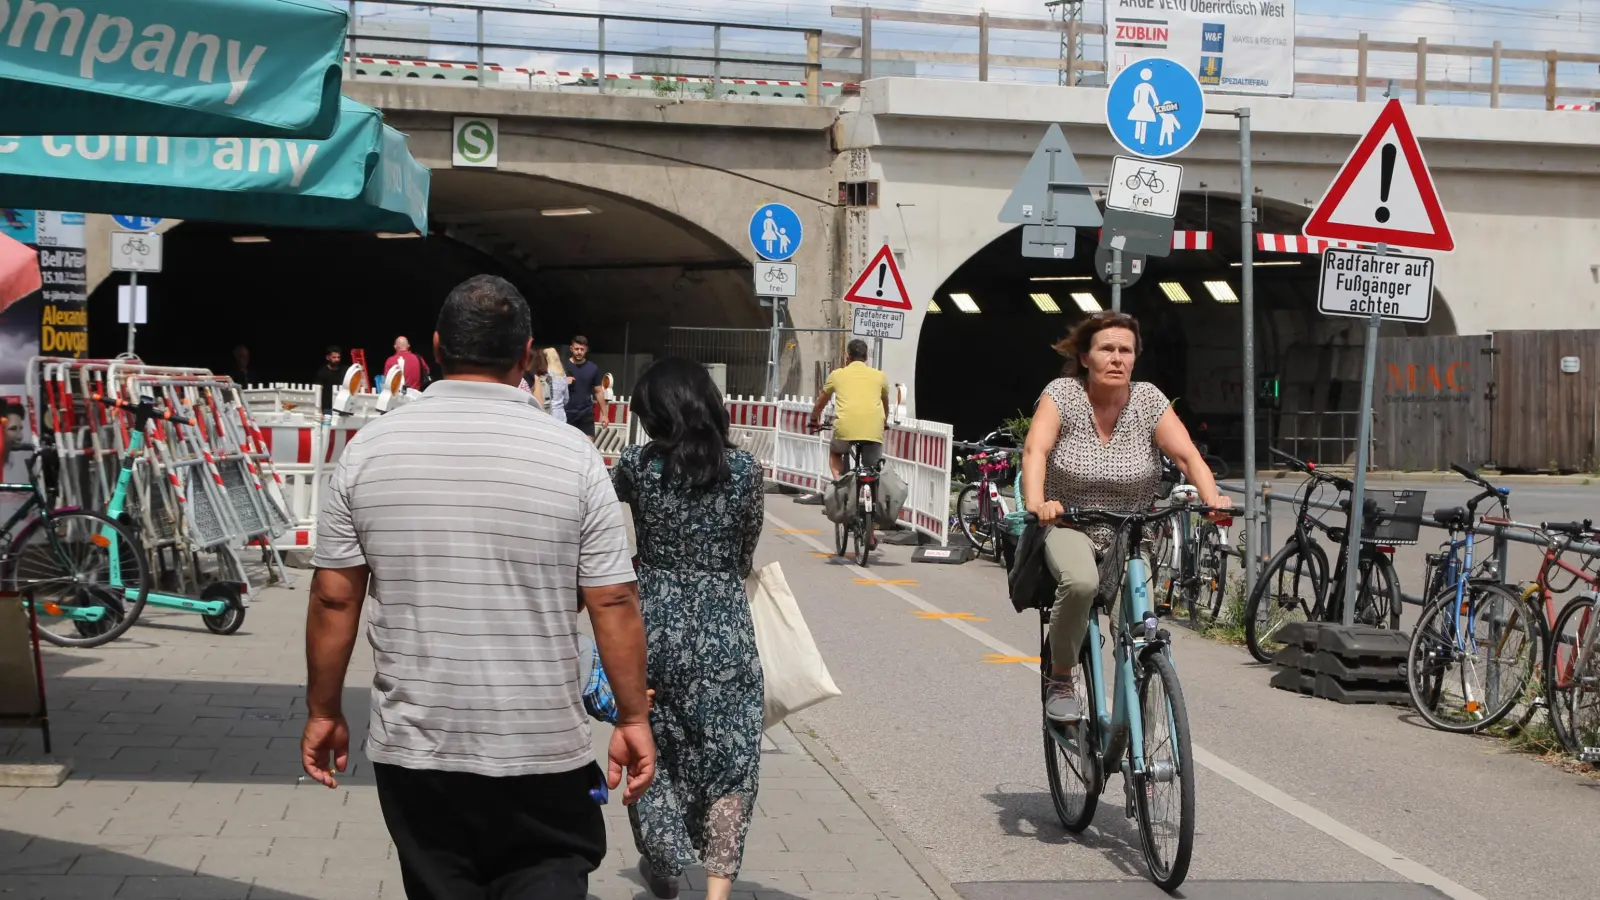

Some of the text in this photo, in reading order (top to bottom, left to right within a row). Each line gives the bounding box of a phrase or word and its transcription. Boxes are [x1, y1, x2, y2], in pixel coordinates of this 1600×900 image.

[1190, 0, 1257, 16] Oberirdisch
[1260, 1, 1285, 17] West
[1116, 25, 1168, 41] ZÜBLIN
[1204, 31, 1222, 41] W&F
[1232, 34, 1254, 44] WAYSS
[1260, 36, 1287, 46] FREYTAG
[0, 0, 267, 105] mpany
[1221, 77, 1268, 86] SPEZIALTIEFBAU
[1326, 252, 1428, 278] Radfahrer auf
[769, 284, 783, 293] frei
[1336, 273, 1411, 299] Fußgänger
[1349, 296, 1399, 314] achten
[855, 310, 889, 320] Radfahrer
[866, 329, 889, 338] achten
[1386, 361, 1473, 391] MAC
